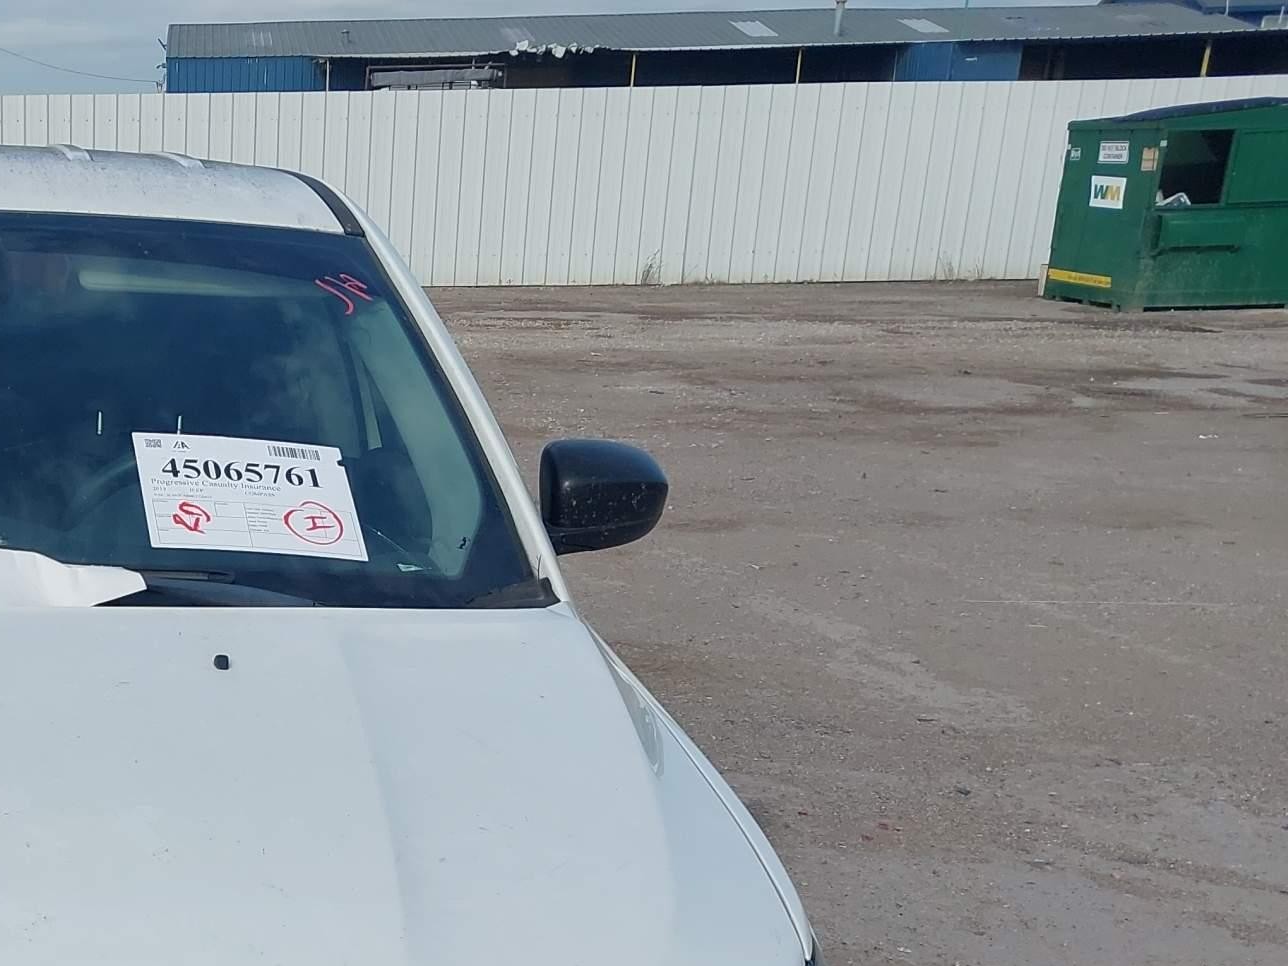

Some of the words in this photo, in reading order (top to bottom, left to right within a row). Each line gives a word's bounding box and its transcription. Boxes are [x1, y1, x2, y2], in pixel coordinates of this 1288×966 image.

[1093, 184, 1121, 201] WM
[161, 457, 323, 488] 45065761
[151, 478, 201, 487] Progressive
[202, 480, 238, 489] Casualty
[241, 483, 281, 492] Insurance
